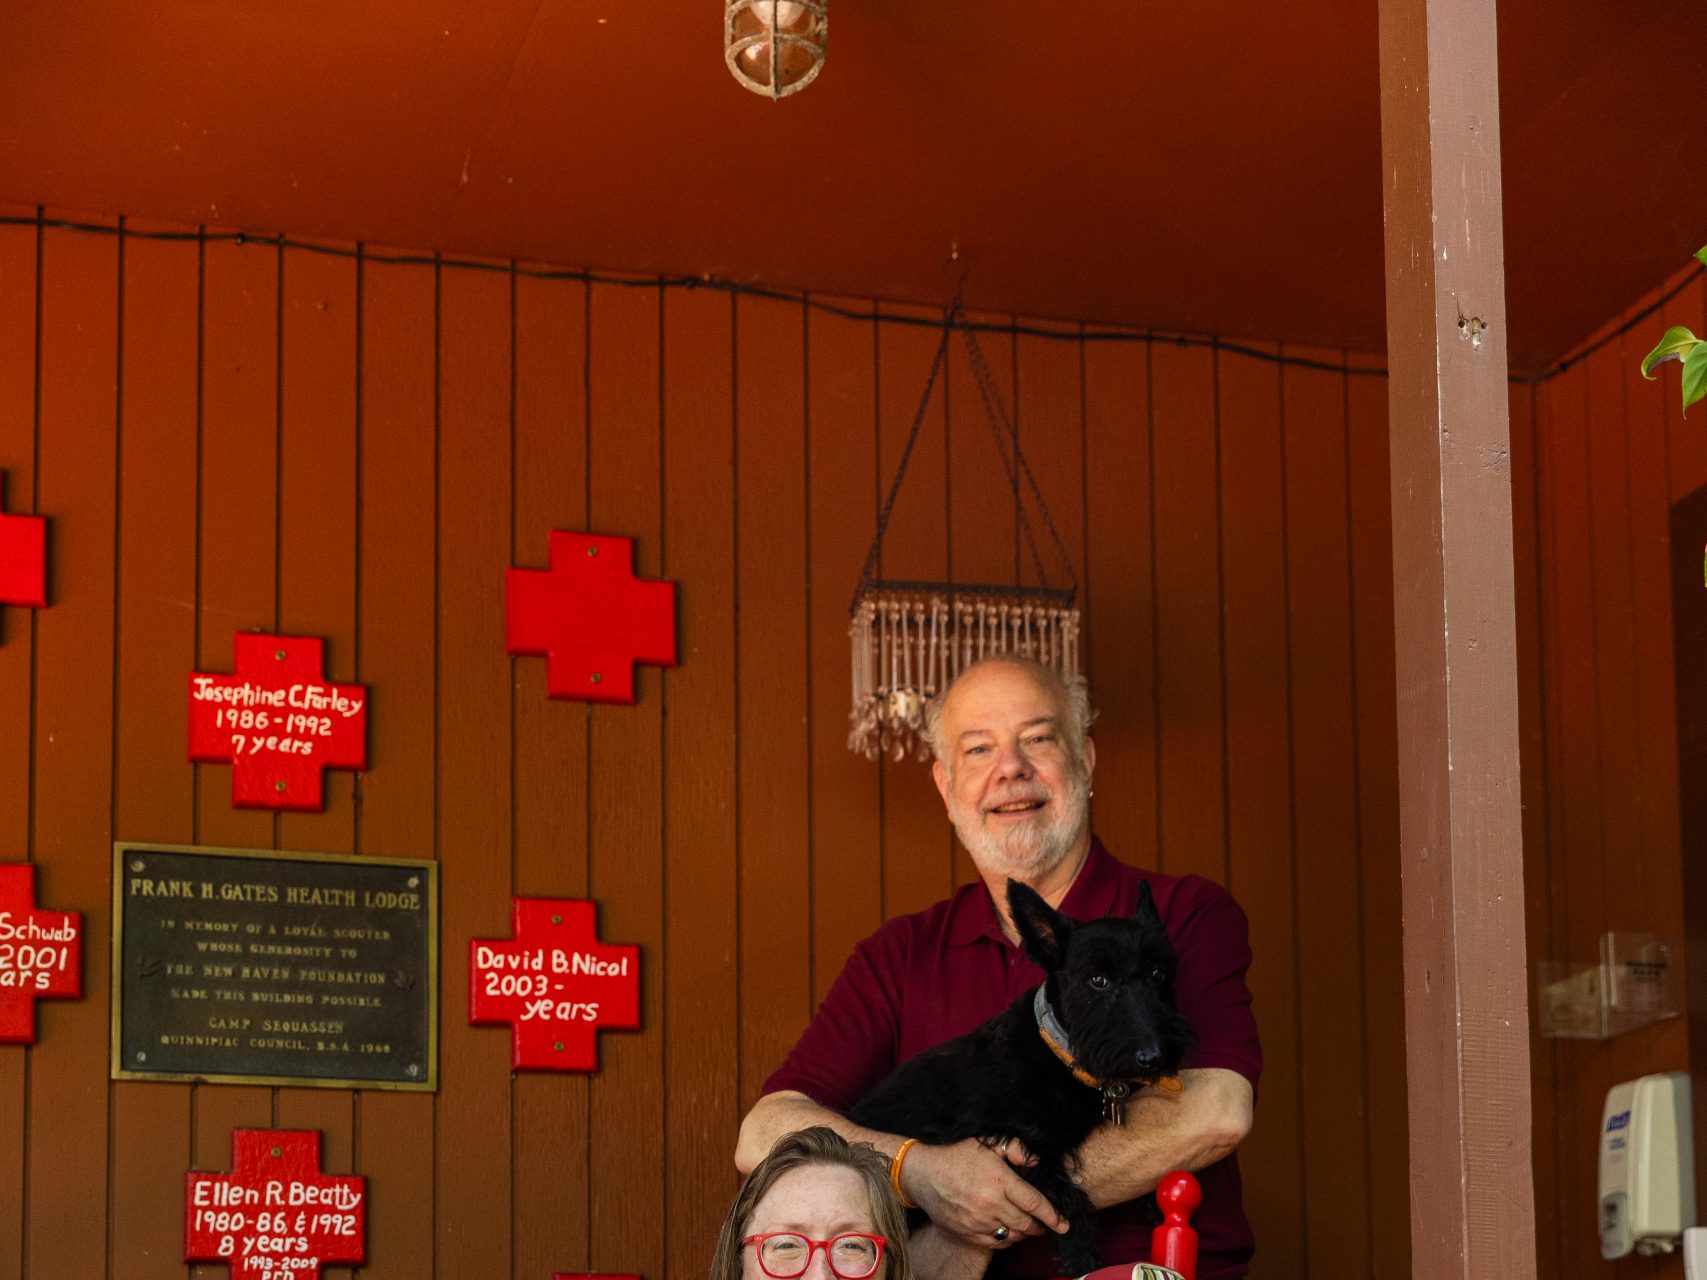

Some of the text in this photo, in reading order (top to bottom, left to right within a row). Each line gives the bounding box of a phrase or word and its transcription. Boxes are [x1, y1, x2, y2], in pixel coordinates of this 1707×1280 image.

[193, 678, 286, 707] Josephine
[232, 734, 313, 755] 7 years
[131, 878, 194, 898] FRANK
[287, 886, 356, 907] HEALTH
[365, 891, 420, 910] LODGE
[0, 911, 76, 942] Schwab
[185, 921, 239, 933] MEMORY
[246, 923, 262, 935] OF
[268, 925, 277, 935] A
[284, 925, 326, 938] LOYAL
[335, 928, 391, 941] SCOUTER
[197, 942, 357, 959] WHOSE GENEROSITY TO
[477, 946, 544, 971] David
[166, 963, 386, 985] THE NEW HAVEN FOUNDATION
[170, 988, 382, 1007] MADE THIS BUILDING POSSIBLE
[520, 999, 600, 1021] years
[208, 1017, 344, 1035] CAMP SEQUASSEN
[161, 1035, 240, 1047] QUINNIPIAC
[194, 1181, 260, 1207] Ellen
[288, 1182, 362, 1210] Beatty
[310, 1214, 357, 1236] 1992
[218, 1235, 309, 1256] 8 years
[244, 1256, 319, 1271] 1993-2009
